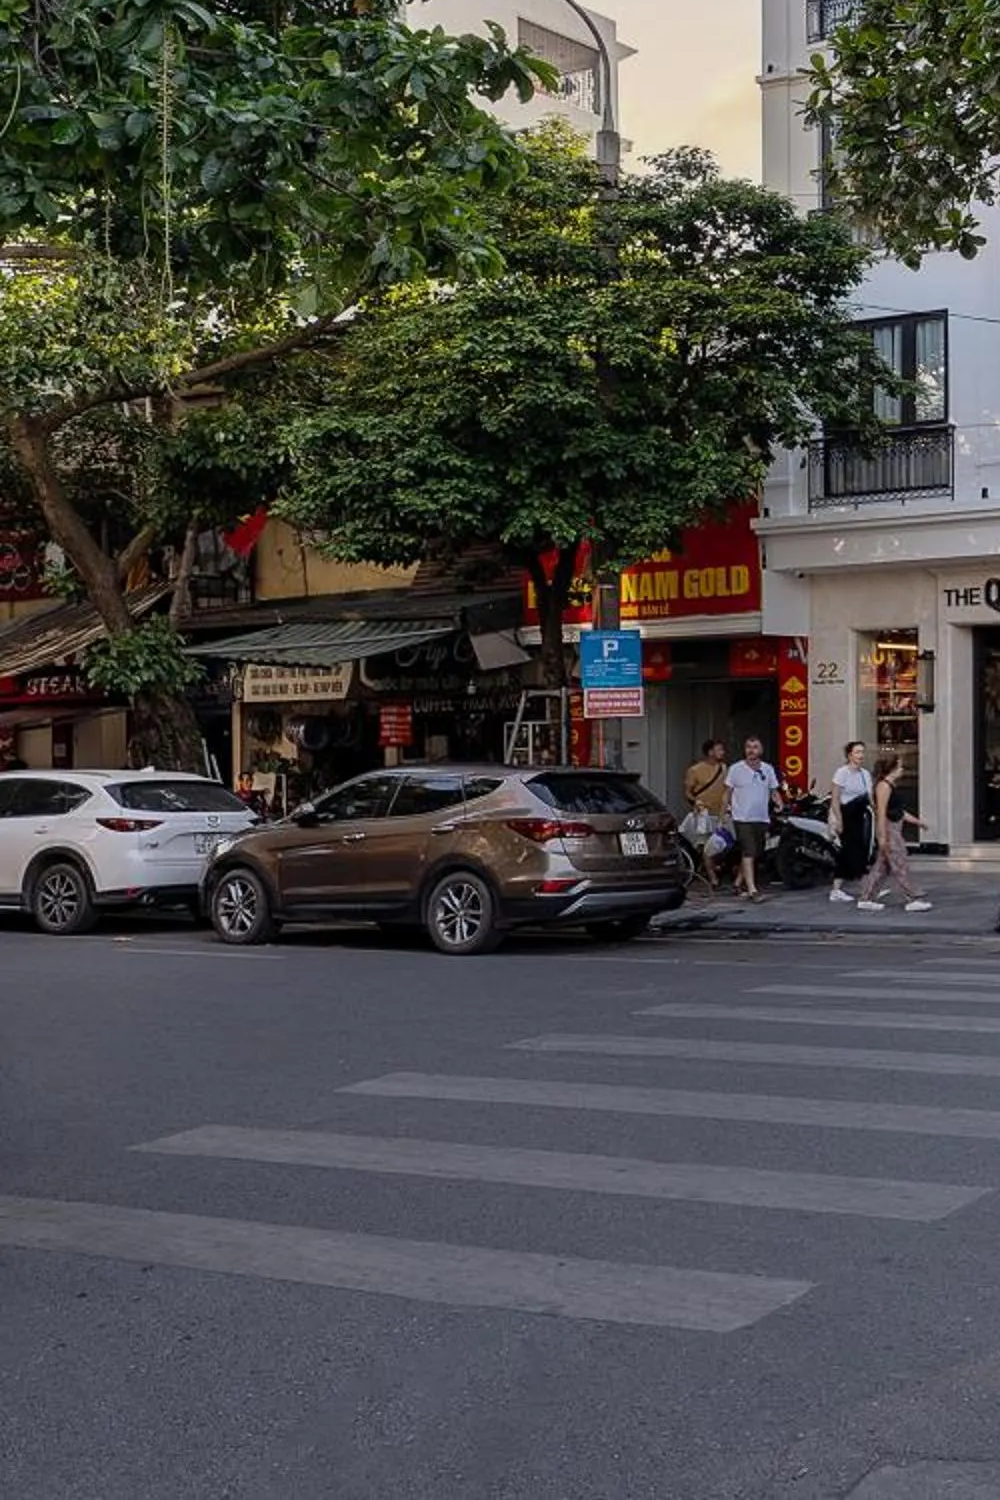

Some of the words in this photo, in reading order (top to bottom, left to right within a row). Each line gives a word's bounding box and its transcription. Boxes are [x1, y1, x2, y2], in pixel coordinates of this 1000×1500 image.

[620, 570, 679, 602] NAM
[683, 564, 750, 599] GOLD
[943, 587, 981, 607] THE
[603, 640, 619, 658] P
[817, 662, 838, 679] 22
[780, 698, 806, 711] PNG
